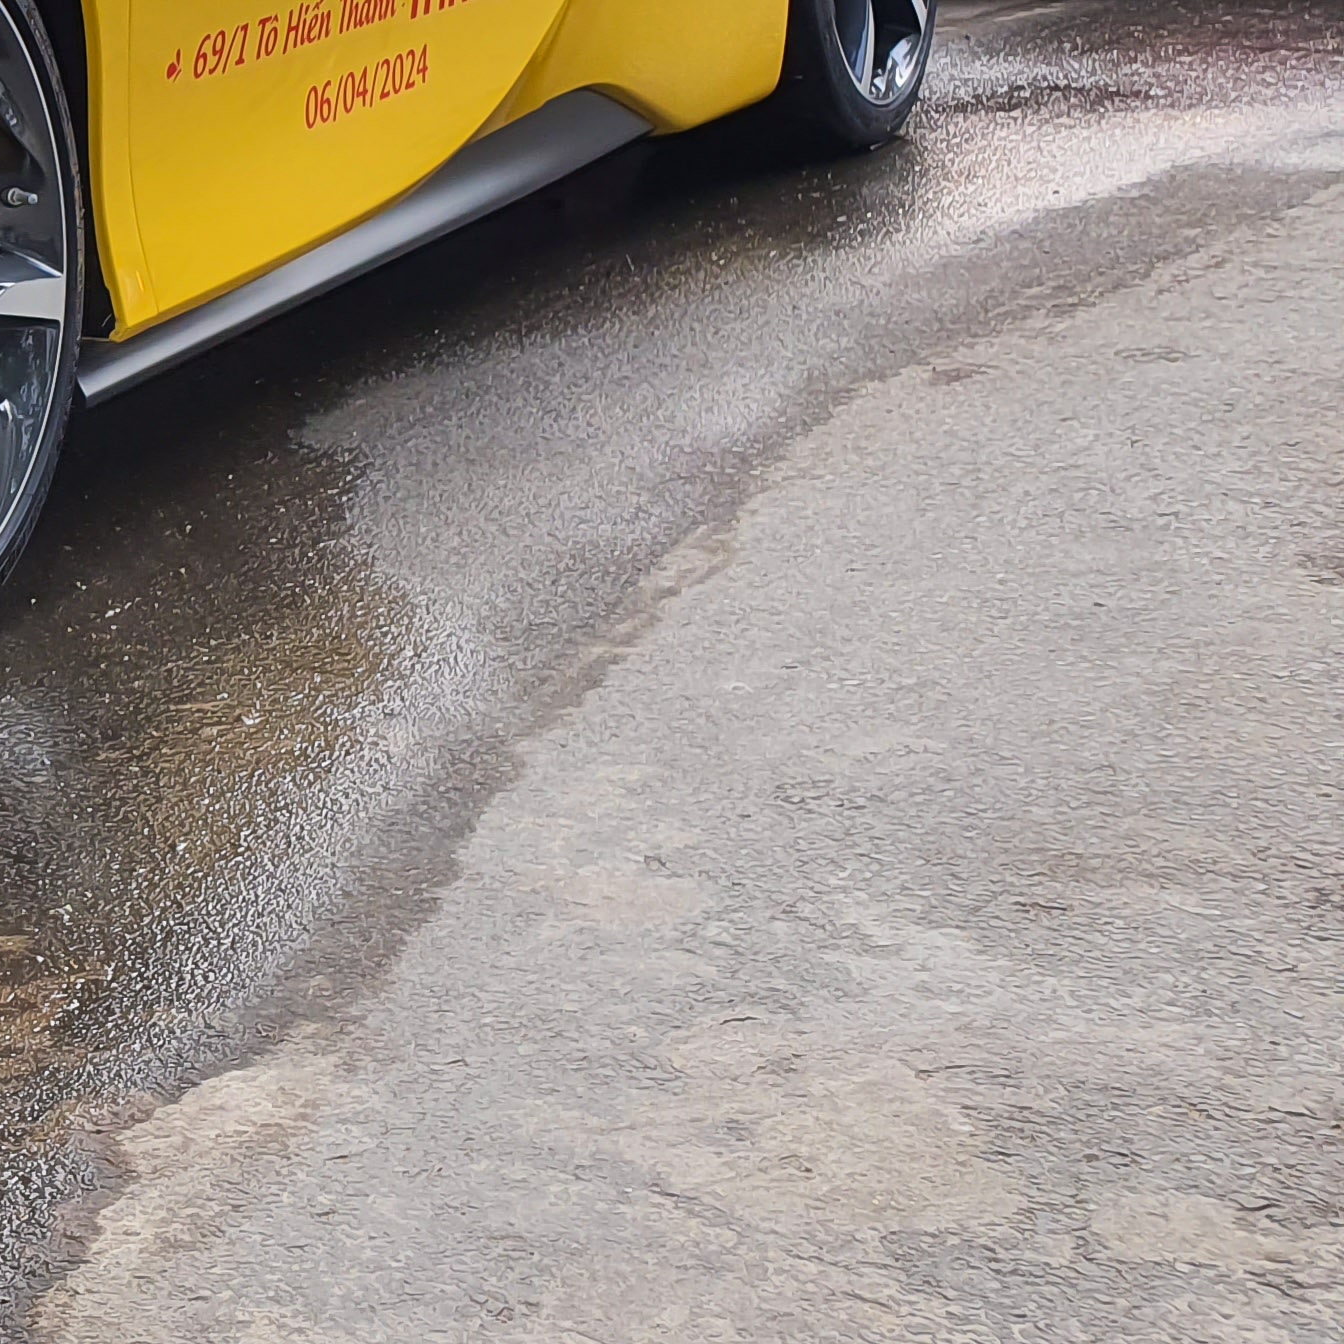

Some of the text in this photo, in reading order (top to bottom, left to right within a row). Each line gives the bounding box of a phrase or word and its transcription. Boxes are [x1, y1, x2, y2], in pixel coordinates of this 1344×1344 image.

[193, 22, 250, 80] 69/1
[256, 12, 279, 61] Tô
[305, 43, 429, 130] 06/04/2024
